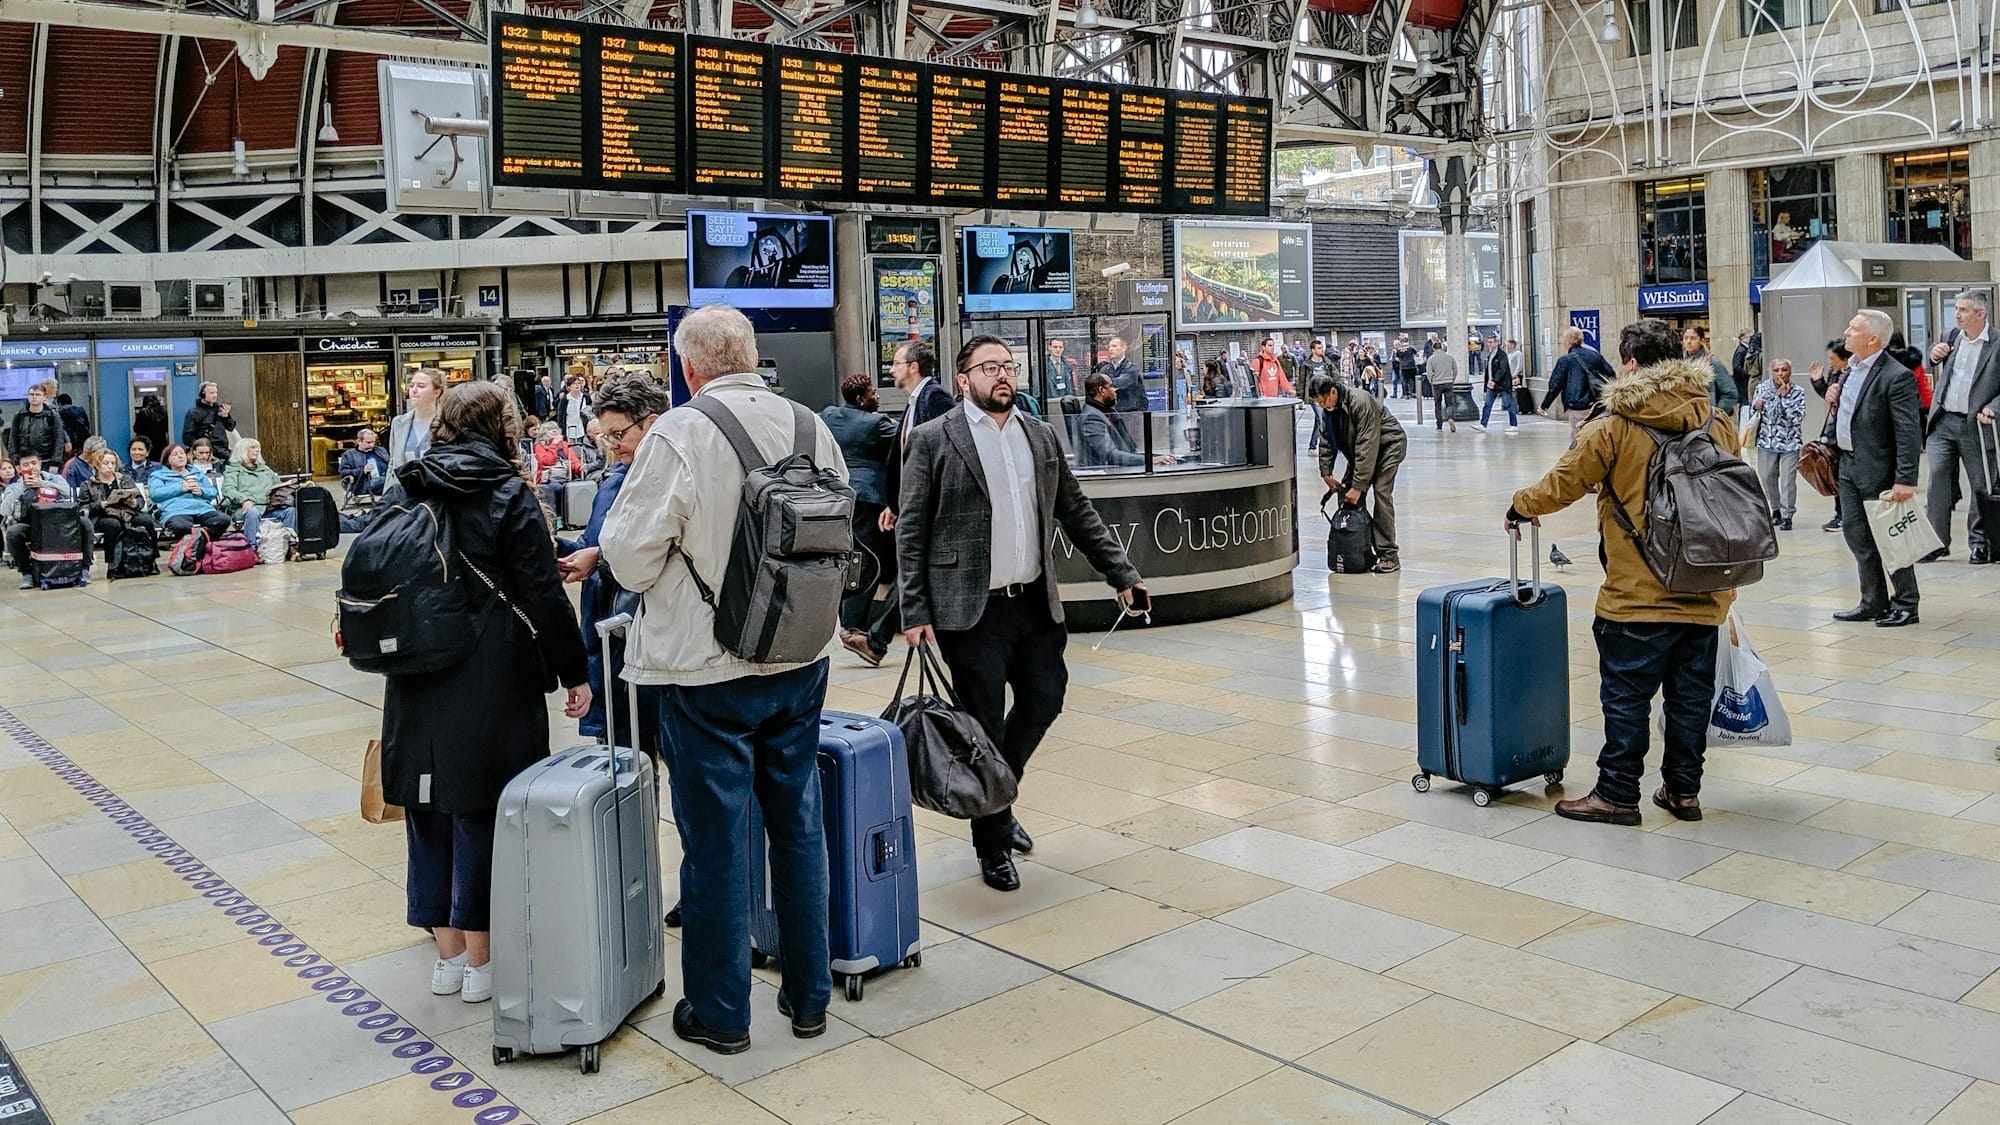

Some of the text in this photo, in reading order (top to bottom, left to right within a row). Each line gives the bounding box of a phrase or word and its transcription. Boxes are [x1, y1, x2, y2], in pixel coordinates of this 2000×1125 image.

[503, 26, 581, 45] 13:22 Boarding
[602, 37, 675, 55] 13:27 Boarding
[601, 50, 634, 63] Cholsey
[697, 48, 763, 64] 13:30 Preparing
[695, 60, 722, 71] Bristol
[733, 64, 756, 75] Meads
[782, 58, 843, 73] 13:33 Pls wait
[781, 70, 816, 82] Heathrow
[503, 165, 523, 173] GWR
[708, 216, 724, 224] SEE
[708, 224, 726, 234] SAY
[880, 276, 931, 290] escape
[1136, 282, 1168, 295] Paddington
[392, 293, 408, 305] 12
[481, 289, 496, 302] 14
[1142, 296, 1163, 306] Station
[1643, 289, 1704, 305] WHSmith
[881, 302, 906, 314] YOUR
[1573, 316, 1598, 328] WH
[0, 347, 35, 355] URRENCY
[1154, 503, 1290, 554] Custome
[1718, 731, 1735, 740] Join
